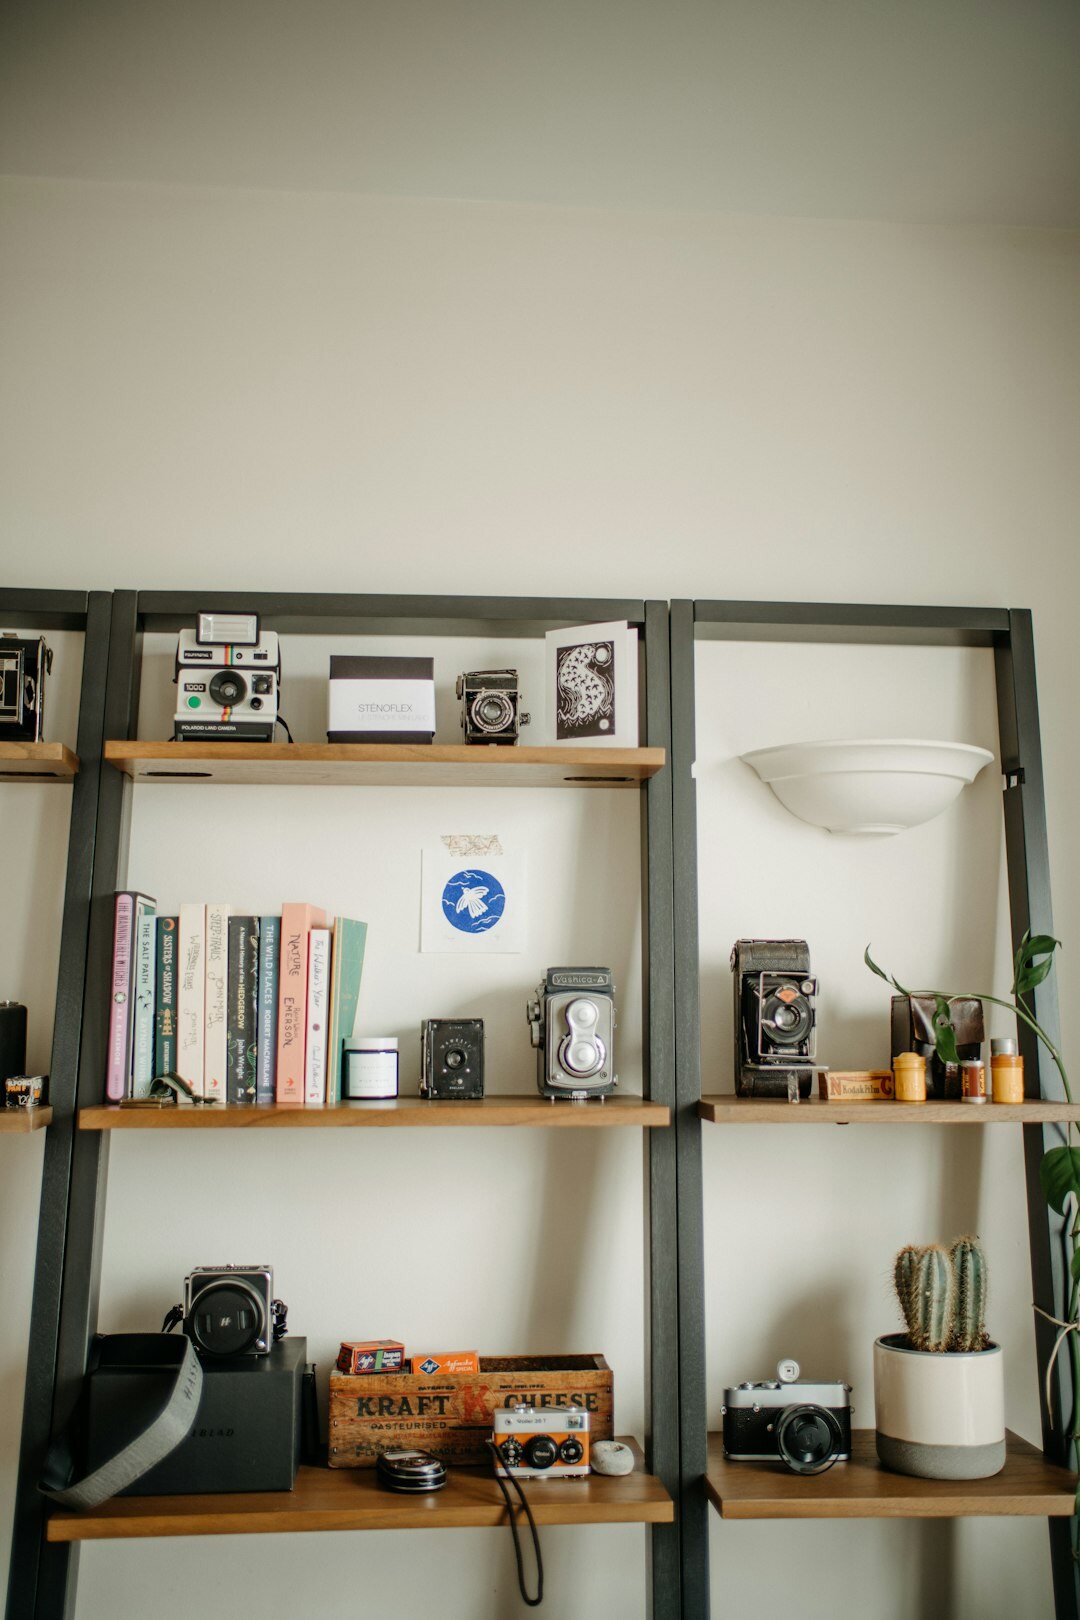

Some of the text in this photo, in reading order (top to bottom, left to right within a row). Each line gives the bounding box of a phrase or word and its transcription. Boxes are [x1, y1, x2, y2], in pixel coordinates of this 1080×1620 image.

[358, 702, 413, 712] STÉNOFLEX
[118, 902, 129, 912] THE
[163, 935, 173, 964] SISTERS
[264, 925, 274, 1004] THE WILD PLACES
[287, 934, 301, 976] NATURE
[114, 960, 126, 987] WITCHES
[141, 963, 149, 984] PATH
[162, 972, 173, 1004] SHADOW
[237, 983, 245, 1029] HEDGEROW
[263, 1009, 271, 1036] ROBERT
[283, 997, 295, 1048] EMERSON
[236, 1039, 245, 1079] John Wright
[262, 1039, 271, 1087] MACFARLANE
[842, 1085, 864, 1094] Kodak
[356, 1384, 599, 1421] KRAFT K CHEESE
[370, 1422, 447, 1430] PASTEURISED
